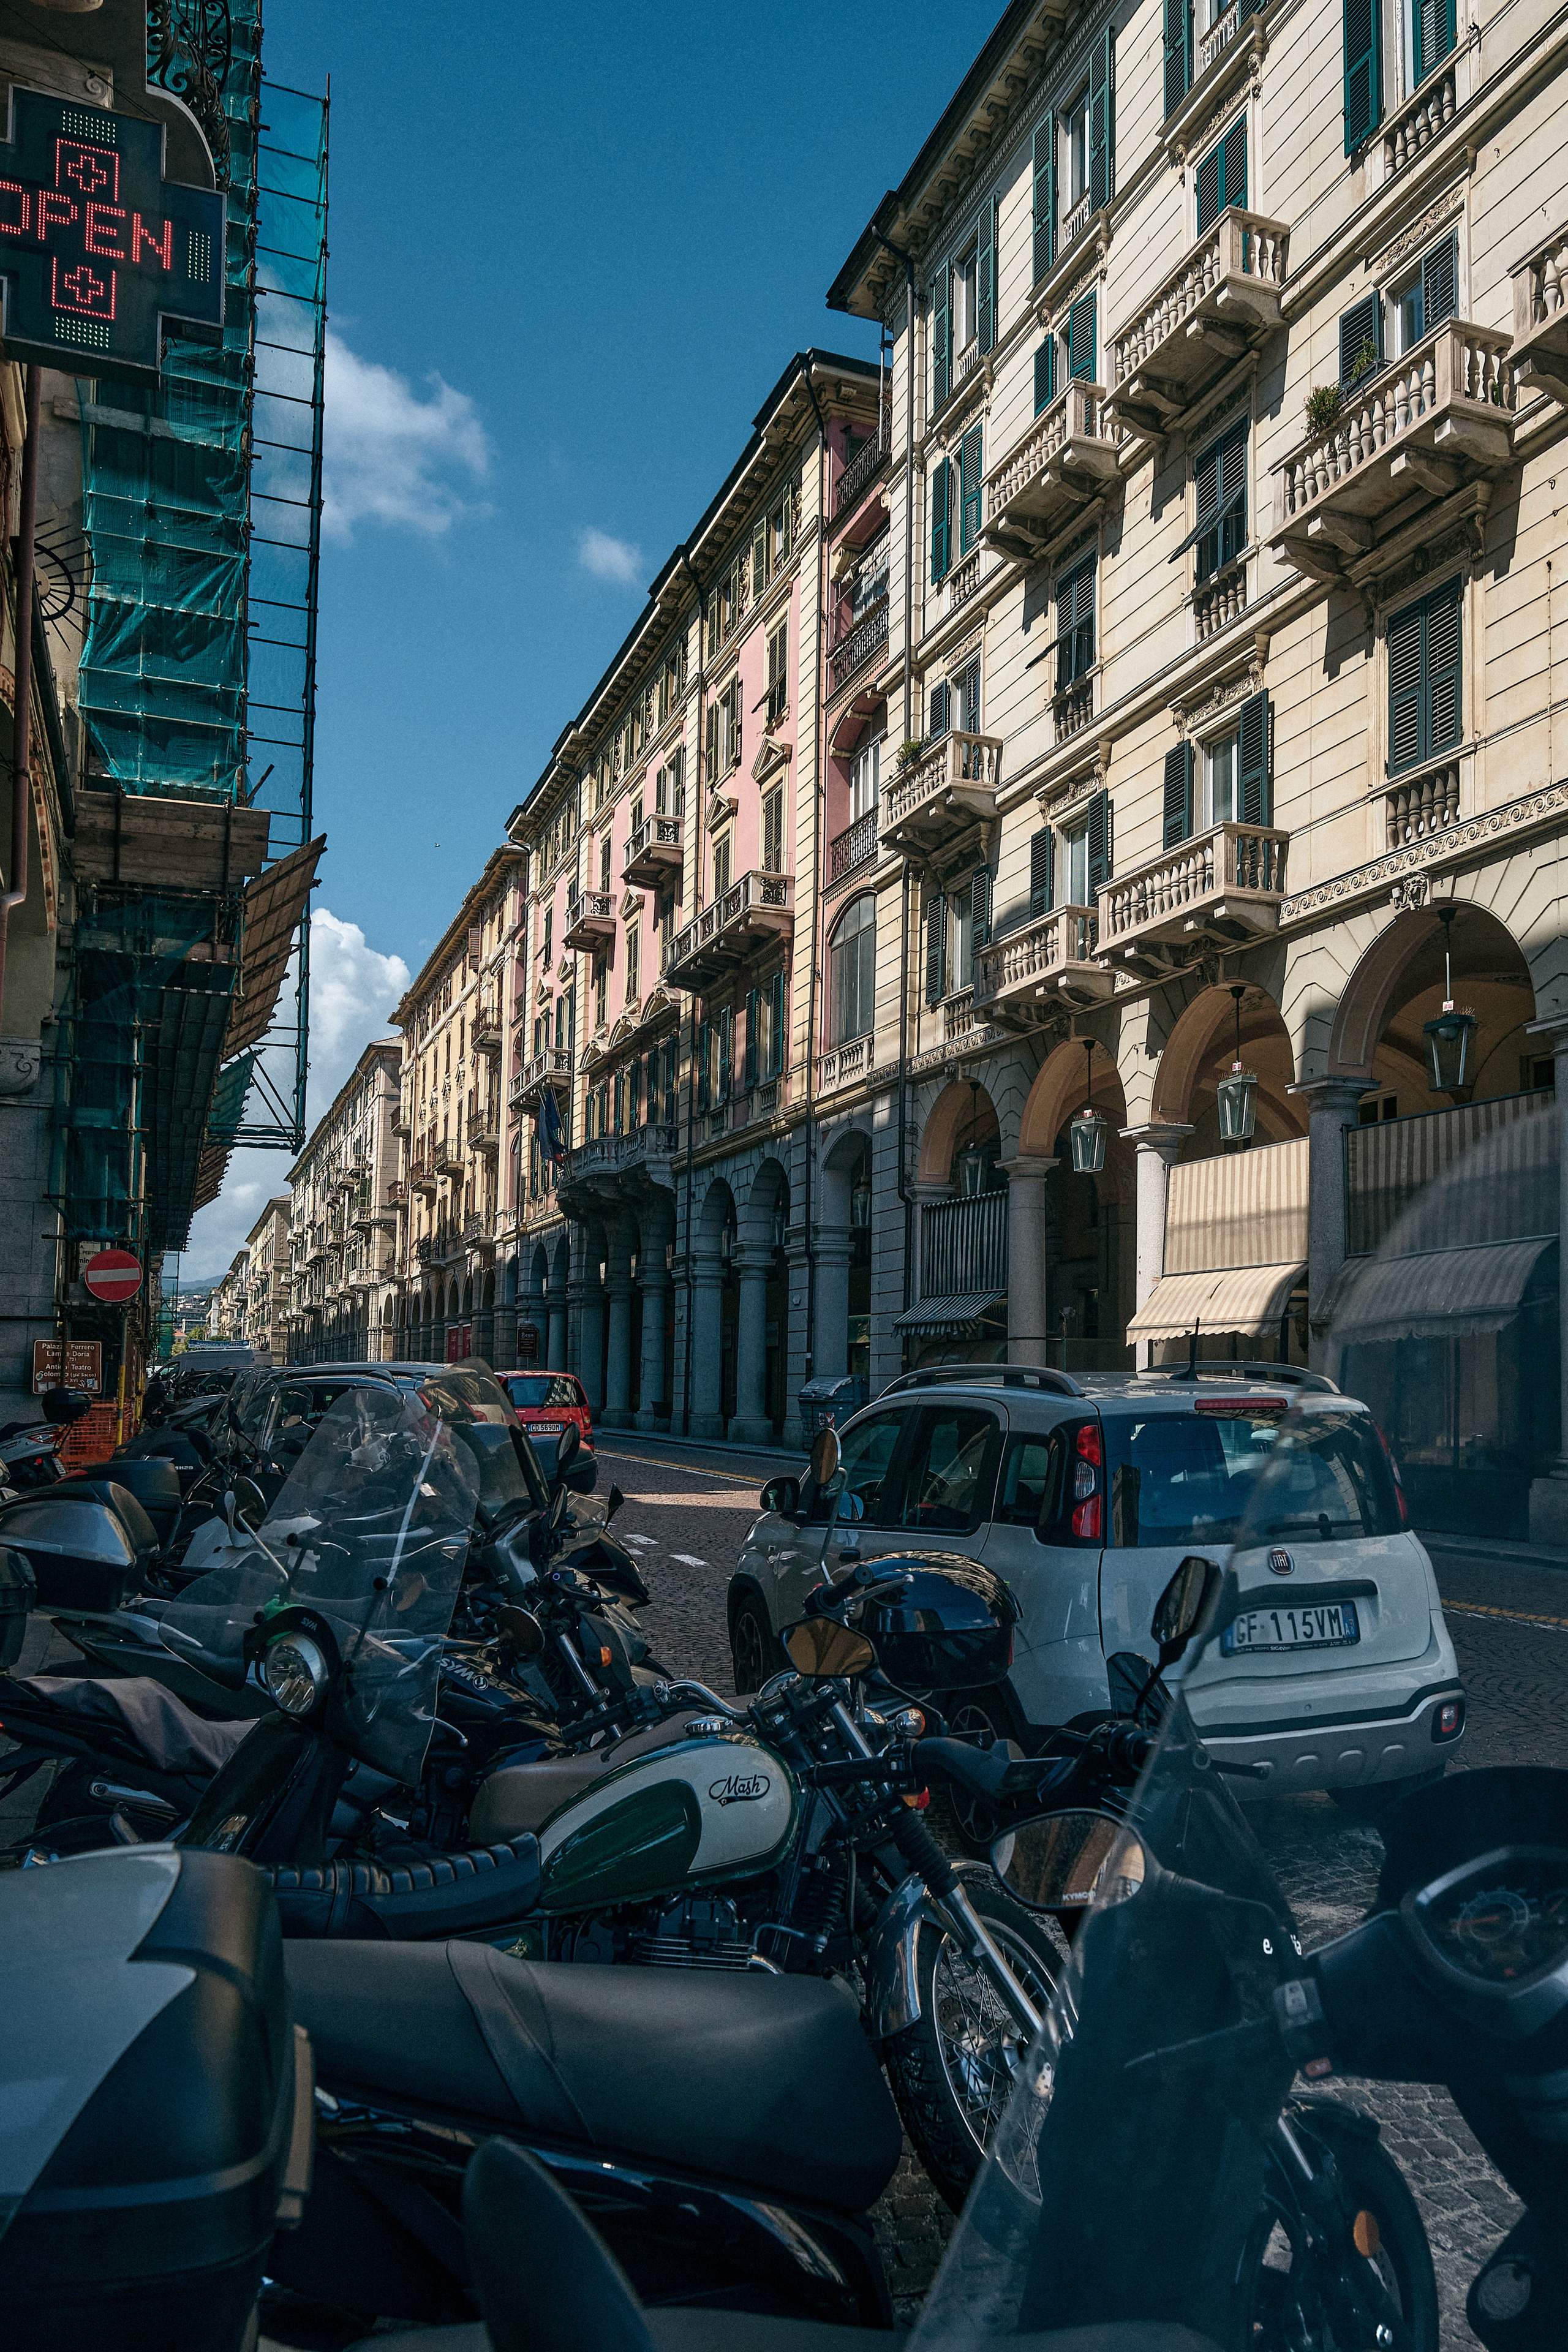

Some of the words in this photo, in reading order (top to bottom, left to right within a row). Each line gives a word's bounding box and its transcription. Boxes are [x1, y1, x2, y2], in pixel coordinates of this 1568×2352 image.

[1272, 1554, 1288, 1567] FIAT
[1270, 1607, 1343, 1642] 115VM
[435, 1657, 475, 1681] SYM
[709, 1774, 770, 1800] Mash
